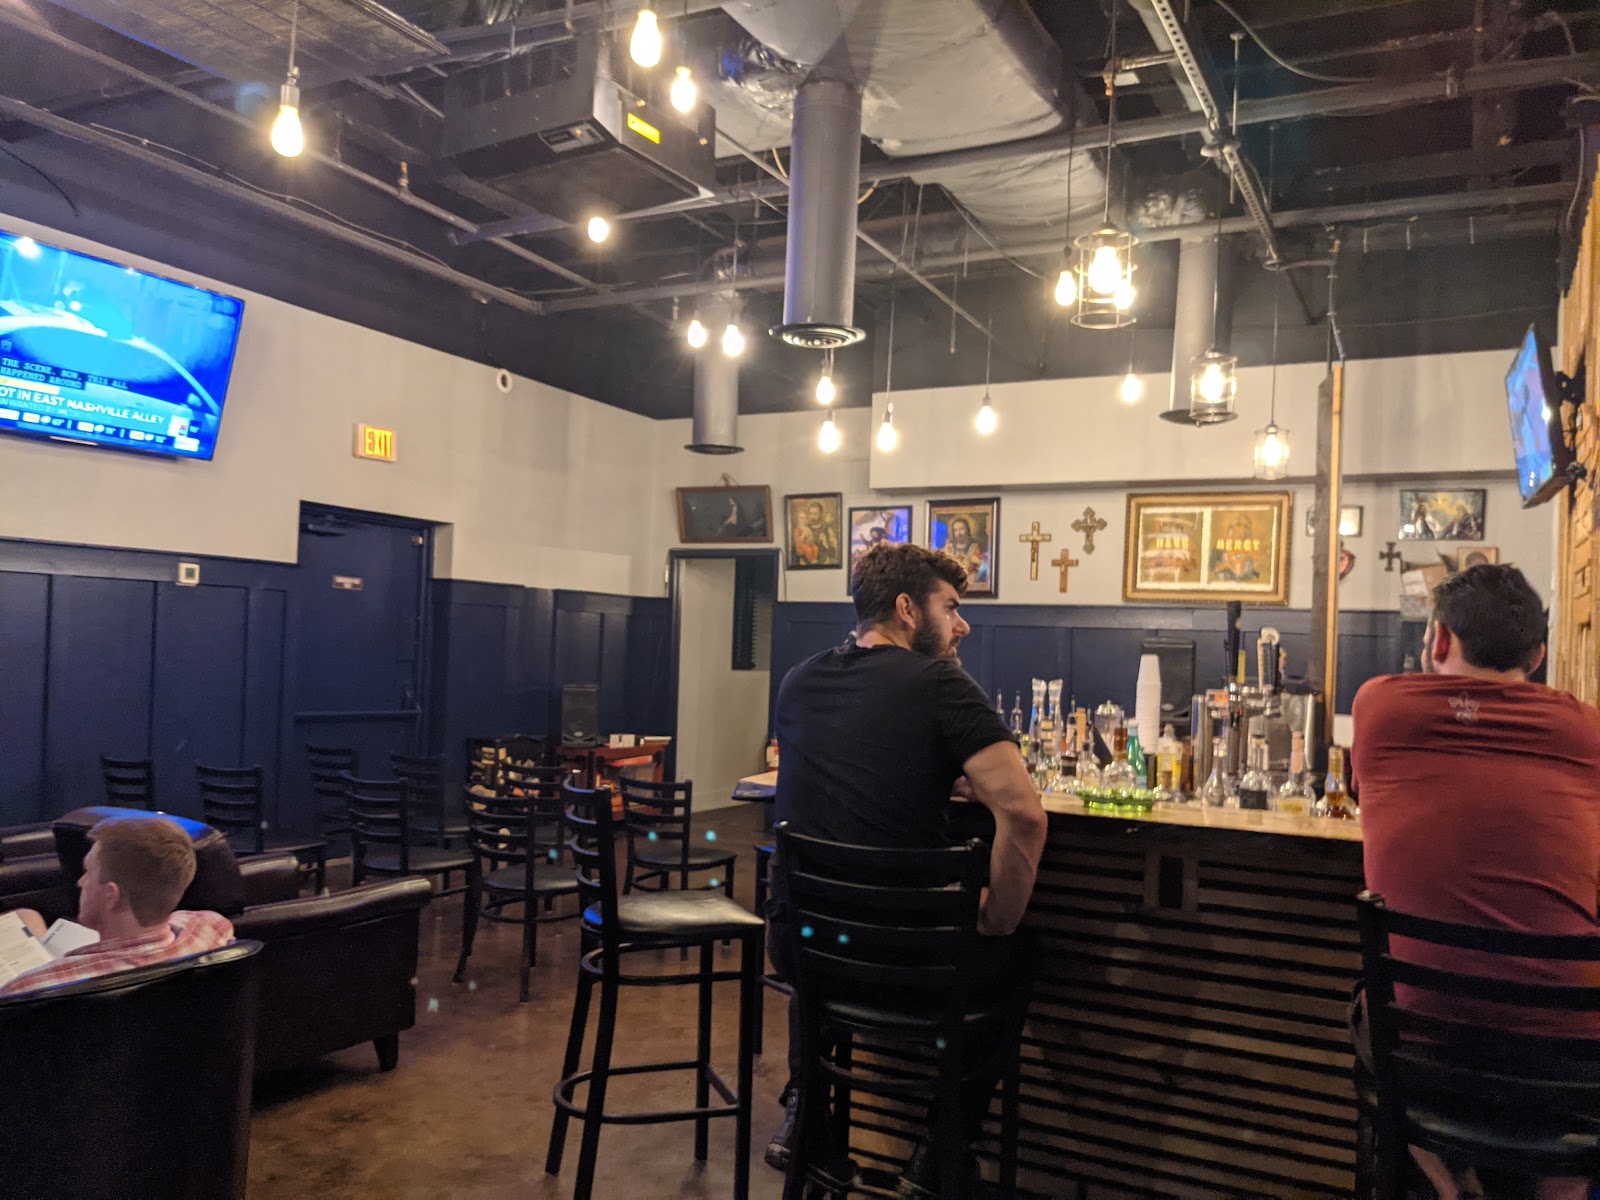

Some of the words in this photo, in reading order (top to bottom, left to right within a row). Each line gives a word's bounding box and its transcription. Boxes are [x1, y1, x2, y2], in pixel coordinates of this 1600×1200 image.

[2, 357, 20, 368] THE
[0, 366, 46, 382] HAPPENED
[17, 389, 31, 401] IN
[33, 392, 66, 407] EAST
[67, 399, 130, 420] NASHVILLE
[132, 411, 165, 424] ALLEY
[364, 426, 393, 459] EXIT
[1156, 537, 1190, 550] HAVE
[1216, 538, 1261, 552] MERCY
